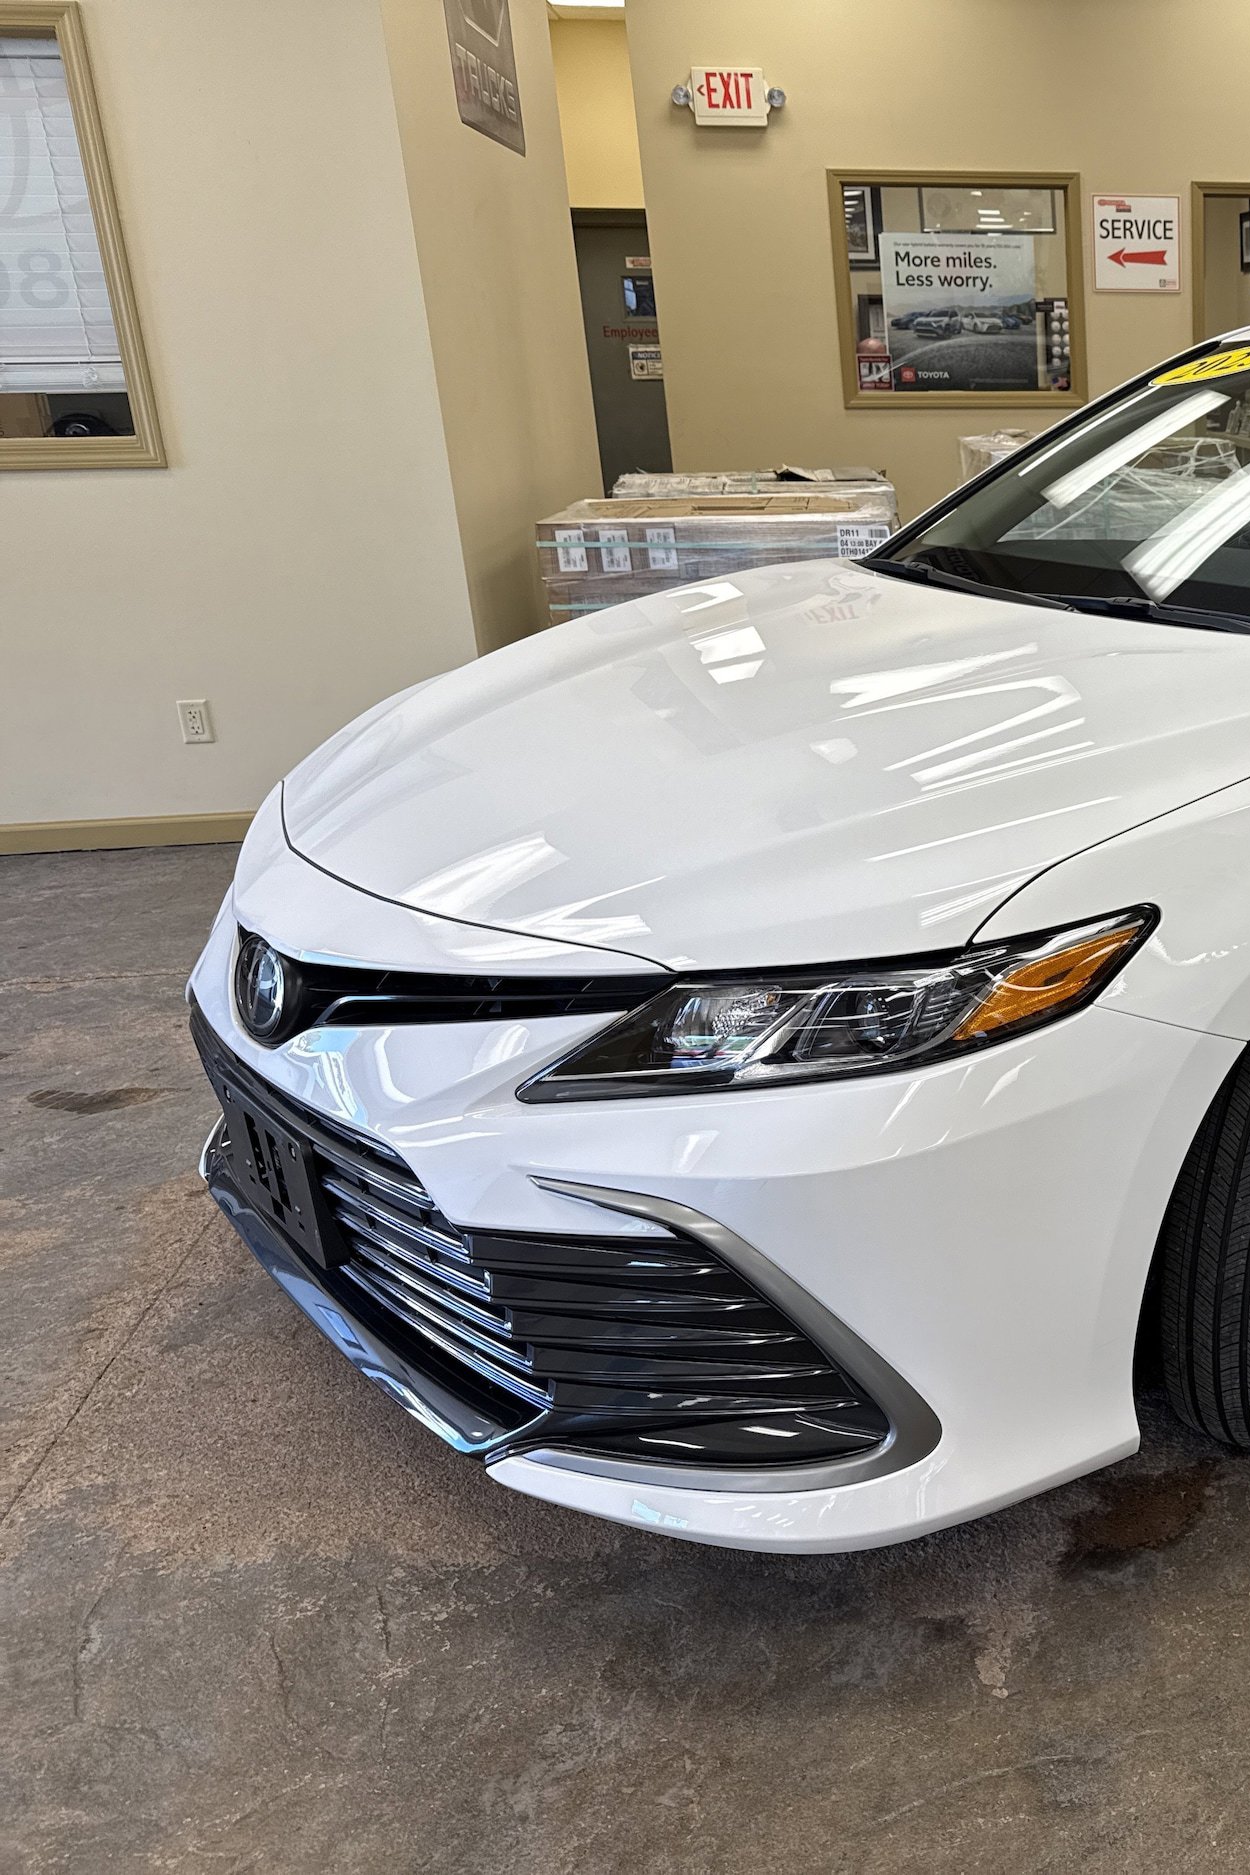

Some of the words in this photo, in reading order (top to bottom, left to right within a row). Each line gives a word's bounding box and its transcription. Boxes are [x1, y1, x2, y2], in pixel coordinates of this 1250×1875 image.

[704, 72, 753, 109] EXIT
[1099, 218, 1174, 240] SERVICE
[894, 251, 941, 268] More
[946, 251, 997, 269] miles.
[896, 270, 934, 287] Less
[938, 275, 993, 292] worry.
[917, 371, 949, 379] TOYOTA
[840, 529, 859, 537] DR11
